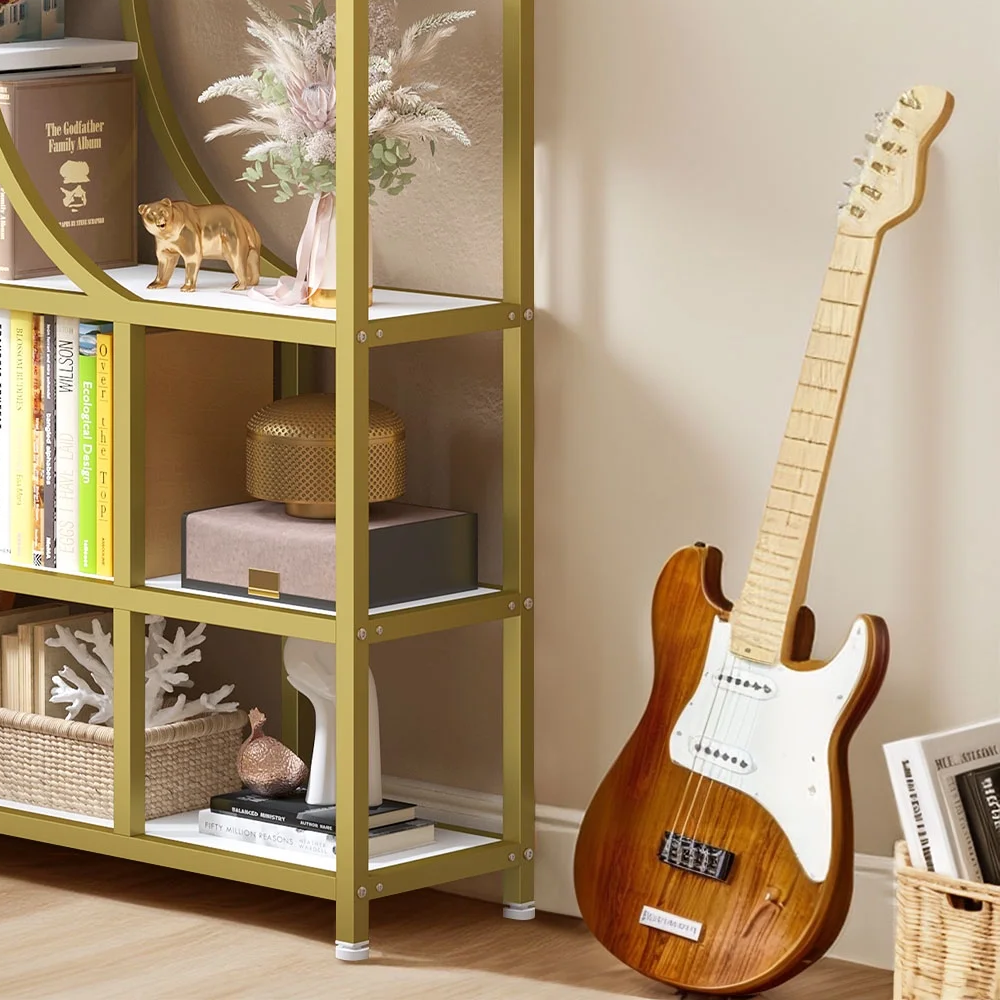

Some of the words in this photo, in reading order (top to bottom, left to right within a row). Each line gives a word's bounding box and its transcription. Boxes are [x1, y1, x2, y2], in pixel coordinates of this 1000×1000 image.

[45, 122, 62, 137] The
[63, 119, 105, 135] Godfather
[48, 137, 75, 154] Family
[77, 135, 102, 151] Album
[58, 340, 74, 394] WILLSON
[81, 381, 93, 440] Ecological
[81, 443, 93, 484] Design
[231, 807, 259, 817] BALANCED
[259, 811, 287, 822] MINISTRY
[299, 820, 318, 829] AUTHOR
[319, 823, 333, 831] NAME
[203, 821, 224, 833] FIFTY
[226, 827, 257, 839] MILLION
[258, 832, 294, 846] REASONS
